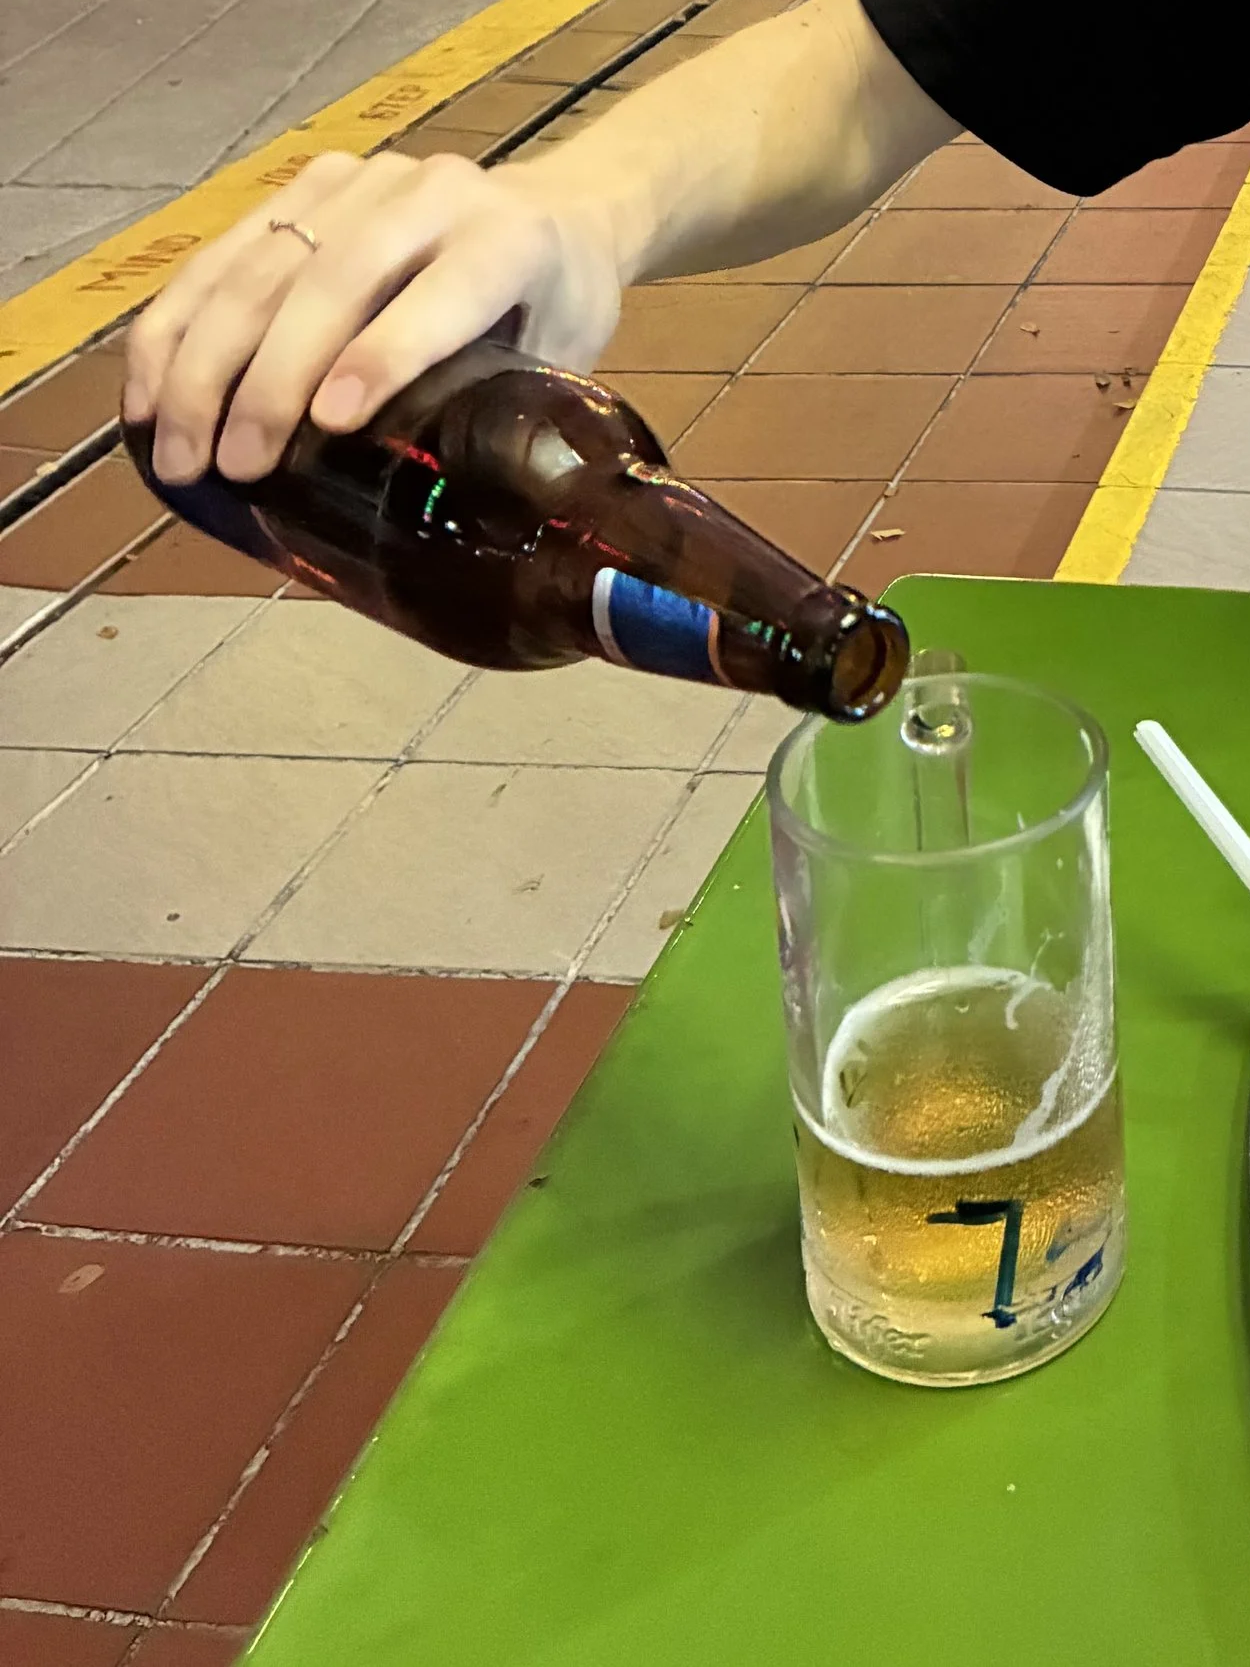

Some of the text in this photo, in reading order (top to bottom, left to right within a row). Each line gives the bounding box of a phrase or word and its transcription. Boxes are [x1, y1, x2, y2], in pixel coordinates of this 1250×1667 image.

[76, 233, 202, 292] MIND
[358, 83, 431, 121] STEP
[926, 1198, 1024, 1329] 7
